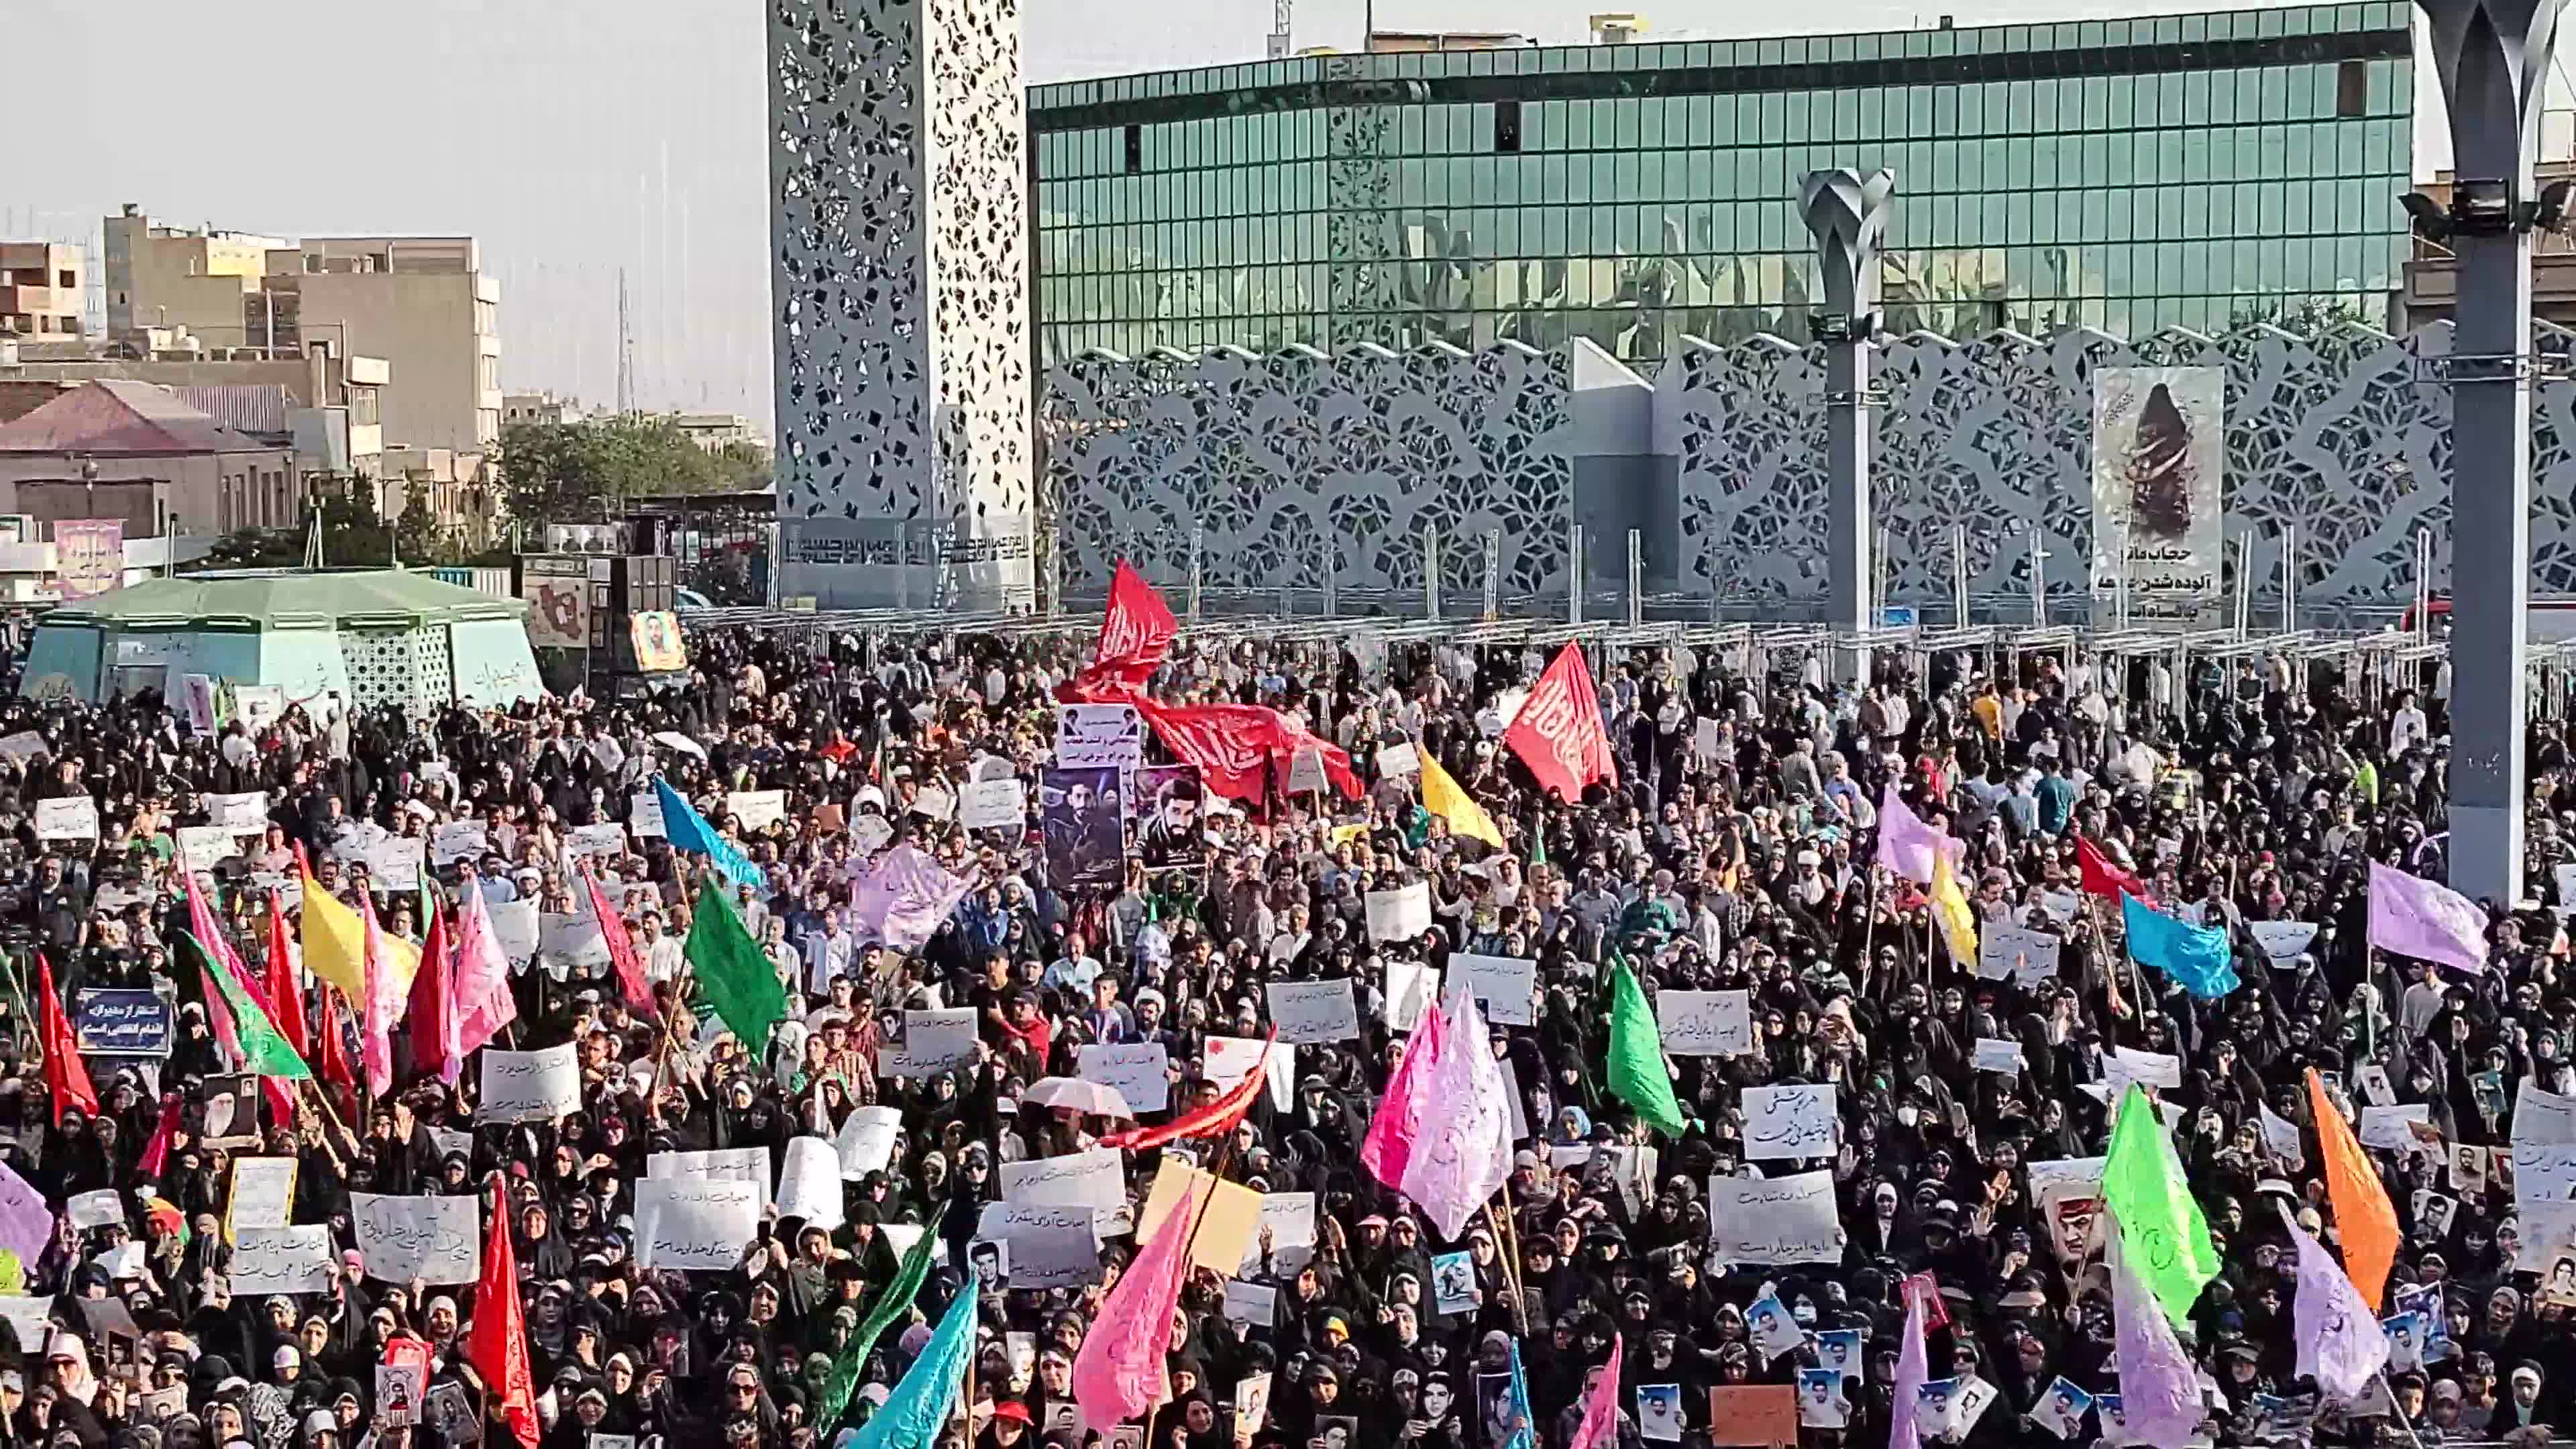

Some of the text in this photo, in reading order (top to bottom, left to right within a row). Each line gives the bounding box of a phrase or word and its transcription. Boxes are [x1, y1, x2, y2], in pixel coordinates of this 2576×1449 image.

[2148, 547, 2192, 566] حجاب
[2140, 573, 2174, 592] شدن
[2174, 573, 2212, 593] آلوده
